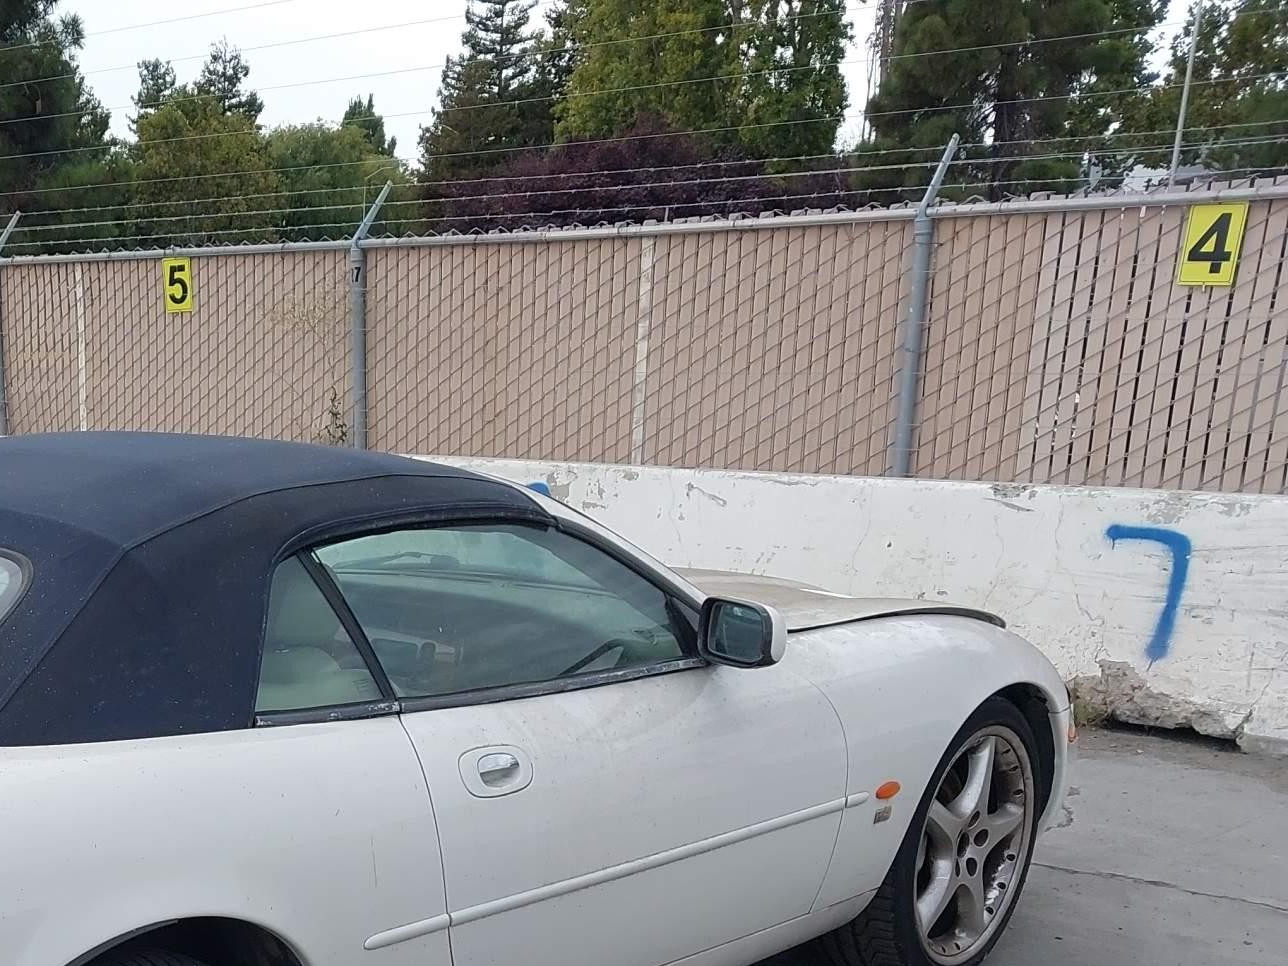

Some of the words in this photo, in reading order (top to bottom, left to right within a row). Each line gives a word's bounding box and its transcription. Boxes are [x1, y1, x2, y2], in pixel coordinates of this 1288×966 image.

[1187, 212, 1233, 274] 4
[168, 264, 188, 305] 5
[1105, 524, 1193, 663] 7
